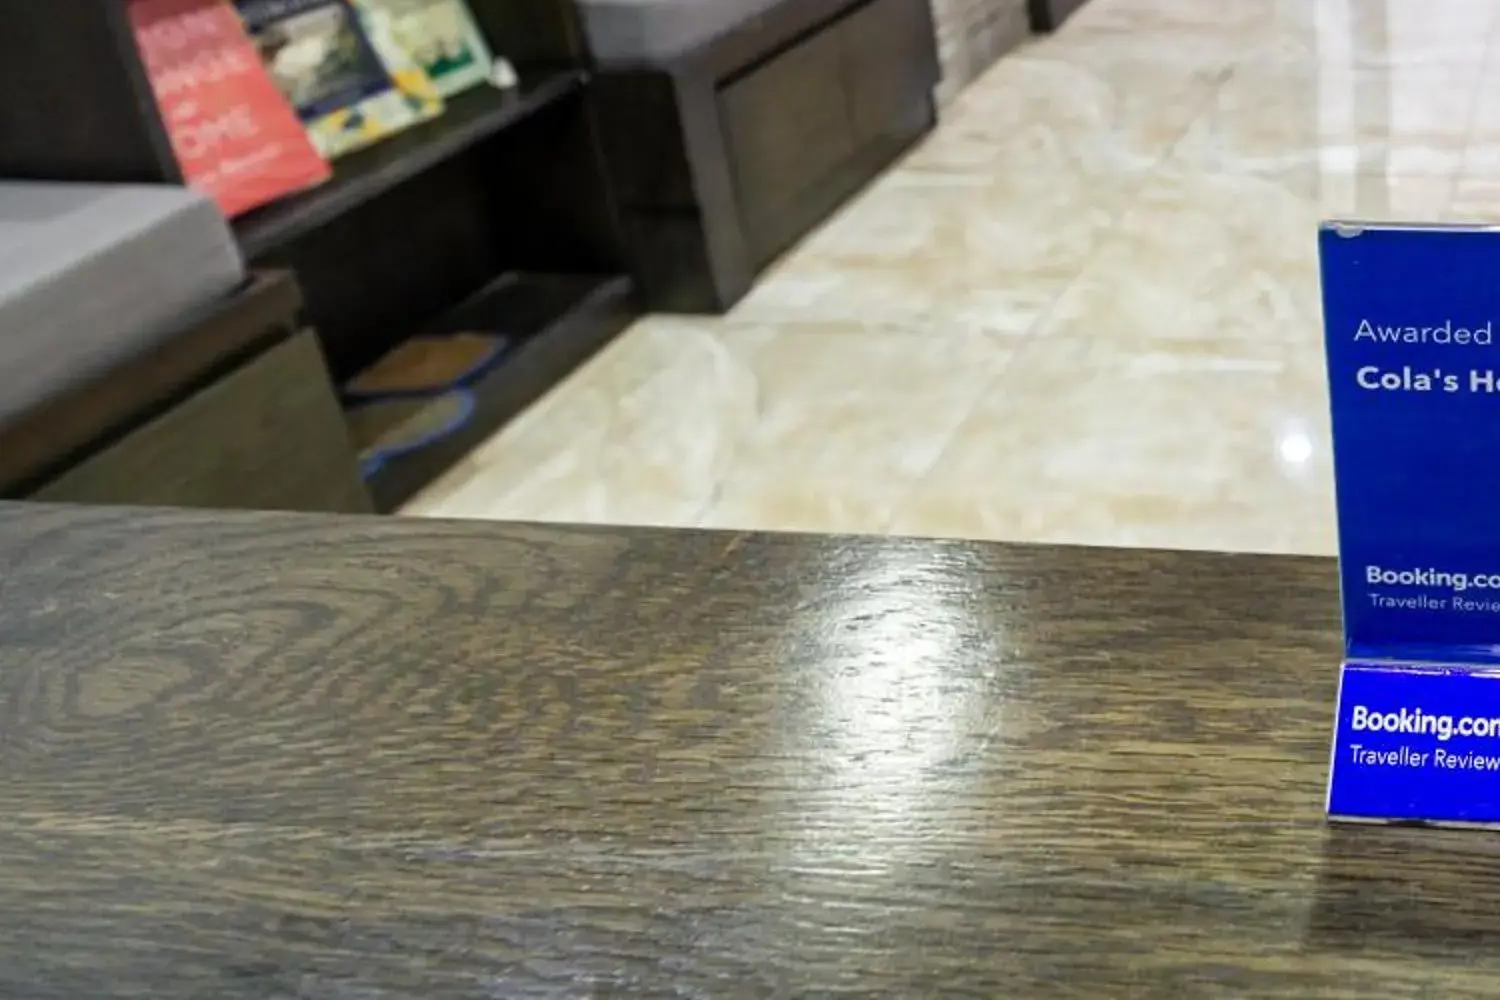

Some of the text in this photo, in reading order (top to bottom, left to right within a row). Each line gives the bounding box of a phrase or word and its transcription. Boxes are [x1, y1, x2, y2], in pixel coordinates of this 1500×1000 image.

[1354, 319, 1491, 345] Awarded
[1357, 366, 1459, 392] Cola's
[1369, 593, 1446, 610] Traveller
[1350, 745, 1427, 768] Traveller
[1434, 749, 1500, 771] Review
